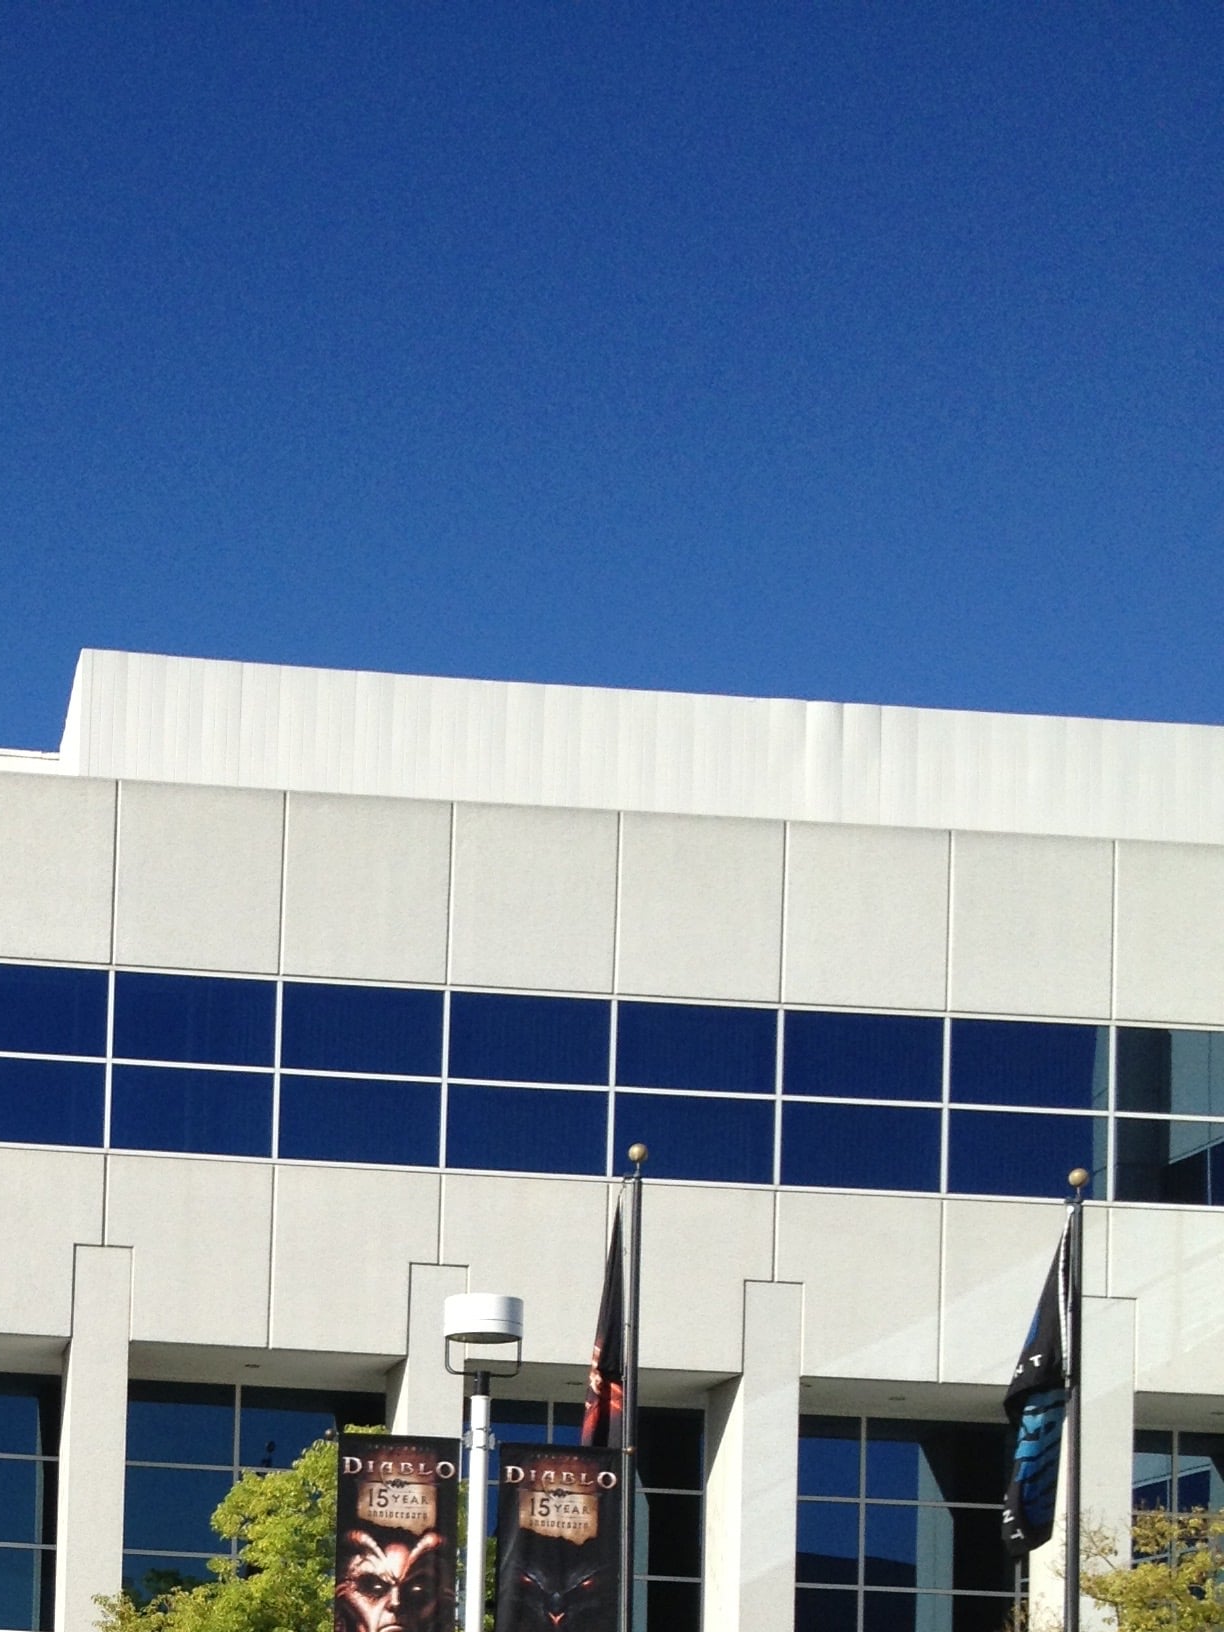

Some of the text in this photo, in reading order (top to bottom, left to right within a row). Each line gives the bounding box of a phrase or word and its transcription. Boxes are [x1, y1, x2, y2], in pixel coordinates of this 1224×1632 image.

[342, 1456, 455, 1479] DIABLO
[504, 1465, 617, 1489] DIABLO
[368, 1487, 429, 1508] 15 YEAR
[530, 1497, 590, 1517] 15 YEAR
